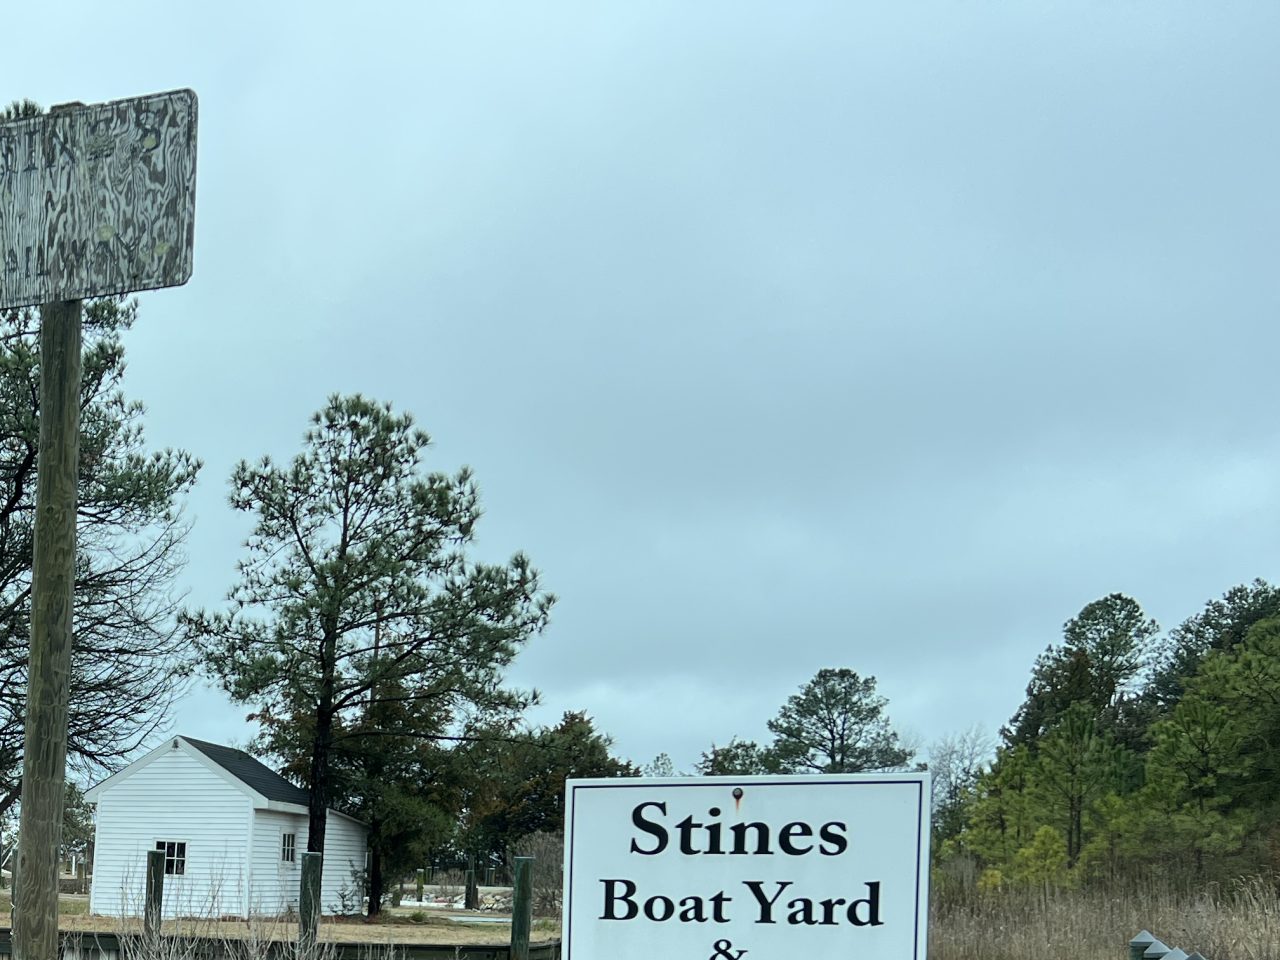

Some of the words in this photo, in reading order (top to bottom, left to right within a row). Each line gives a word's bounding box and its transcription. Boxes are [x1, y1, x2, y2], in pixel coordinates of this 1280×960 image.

[630, 801, 848, 857] Stines
[599, 879, 733, 924] Boat
[741, 880, 885, 927] Yard
